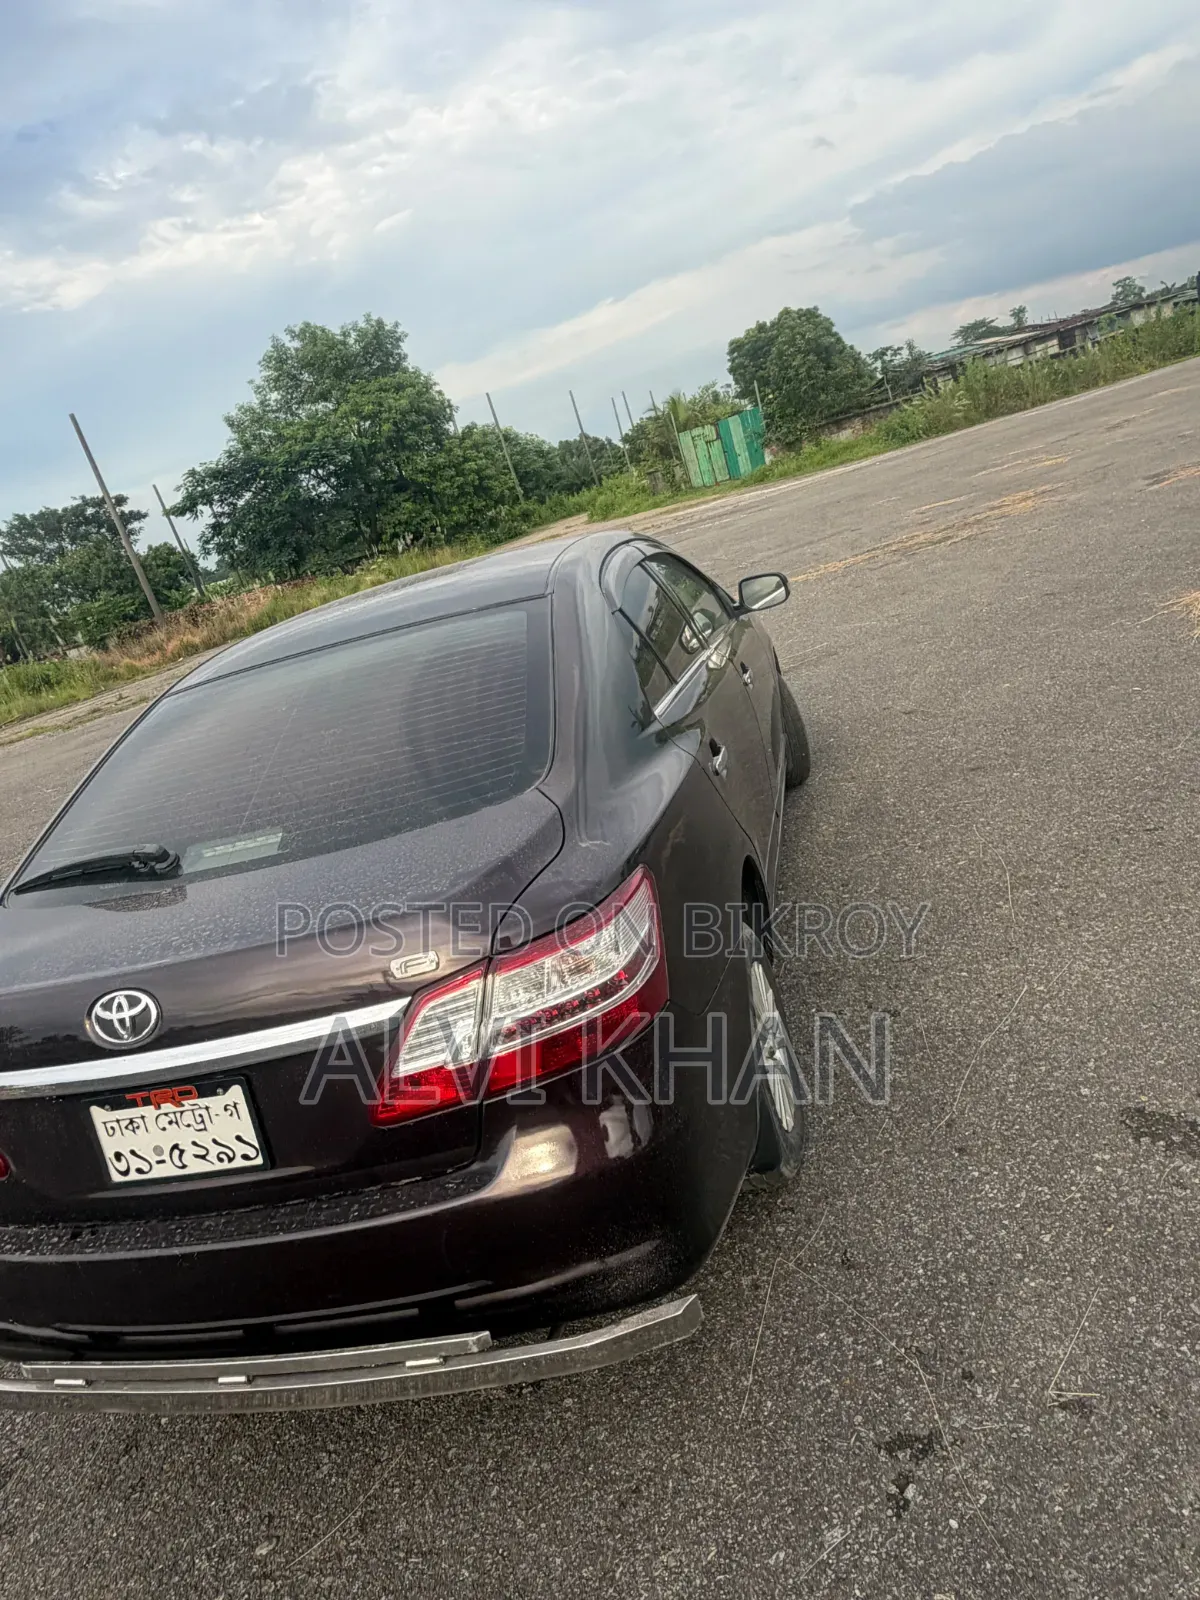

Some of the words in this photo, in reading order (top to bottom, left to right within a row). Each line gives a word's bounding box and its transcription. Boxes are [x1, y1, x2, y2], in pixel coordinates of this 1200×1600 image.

[126, 1085, 198, 1110] TRD
[101, 1113, 149, 1138] ঢাকা
[108, 1134, 260, 1177] ৩১-৫২৯১
